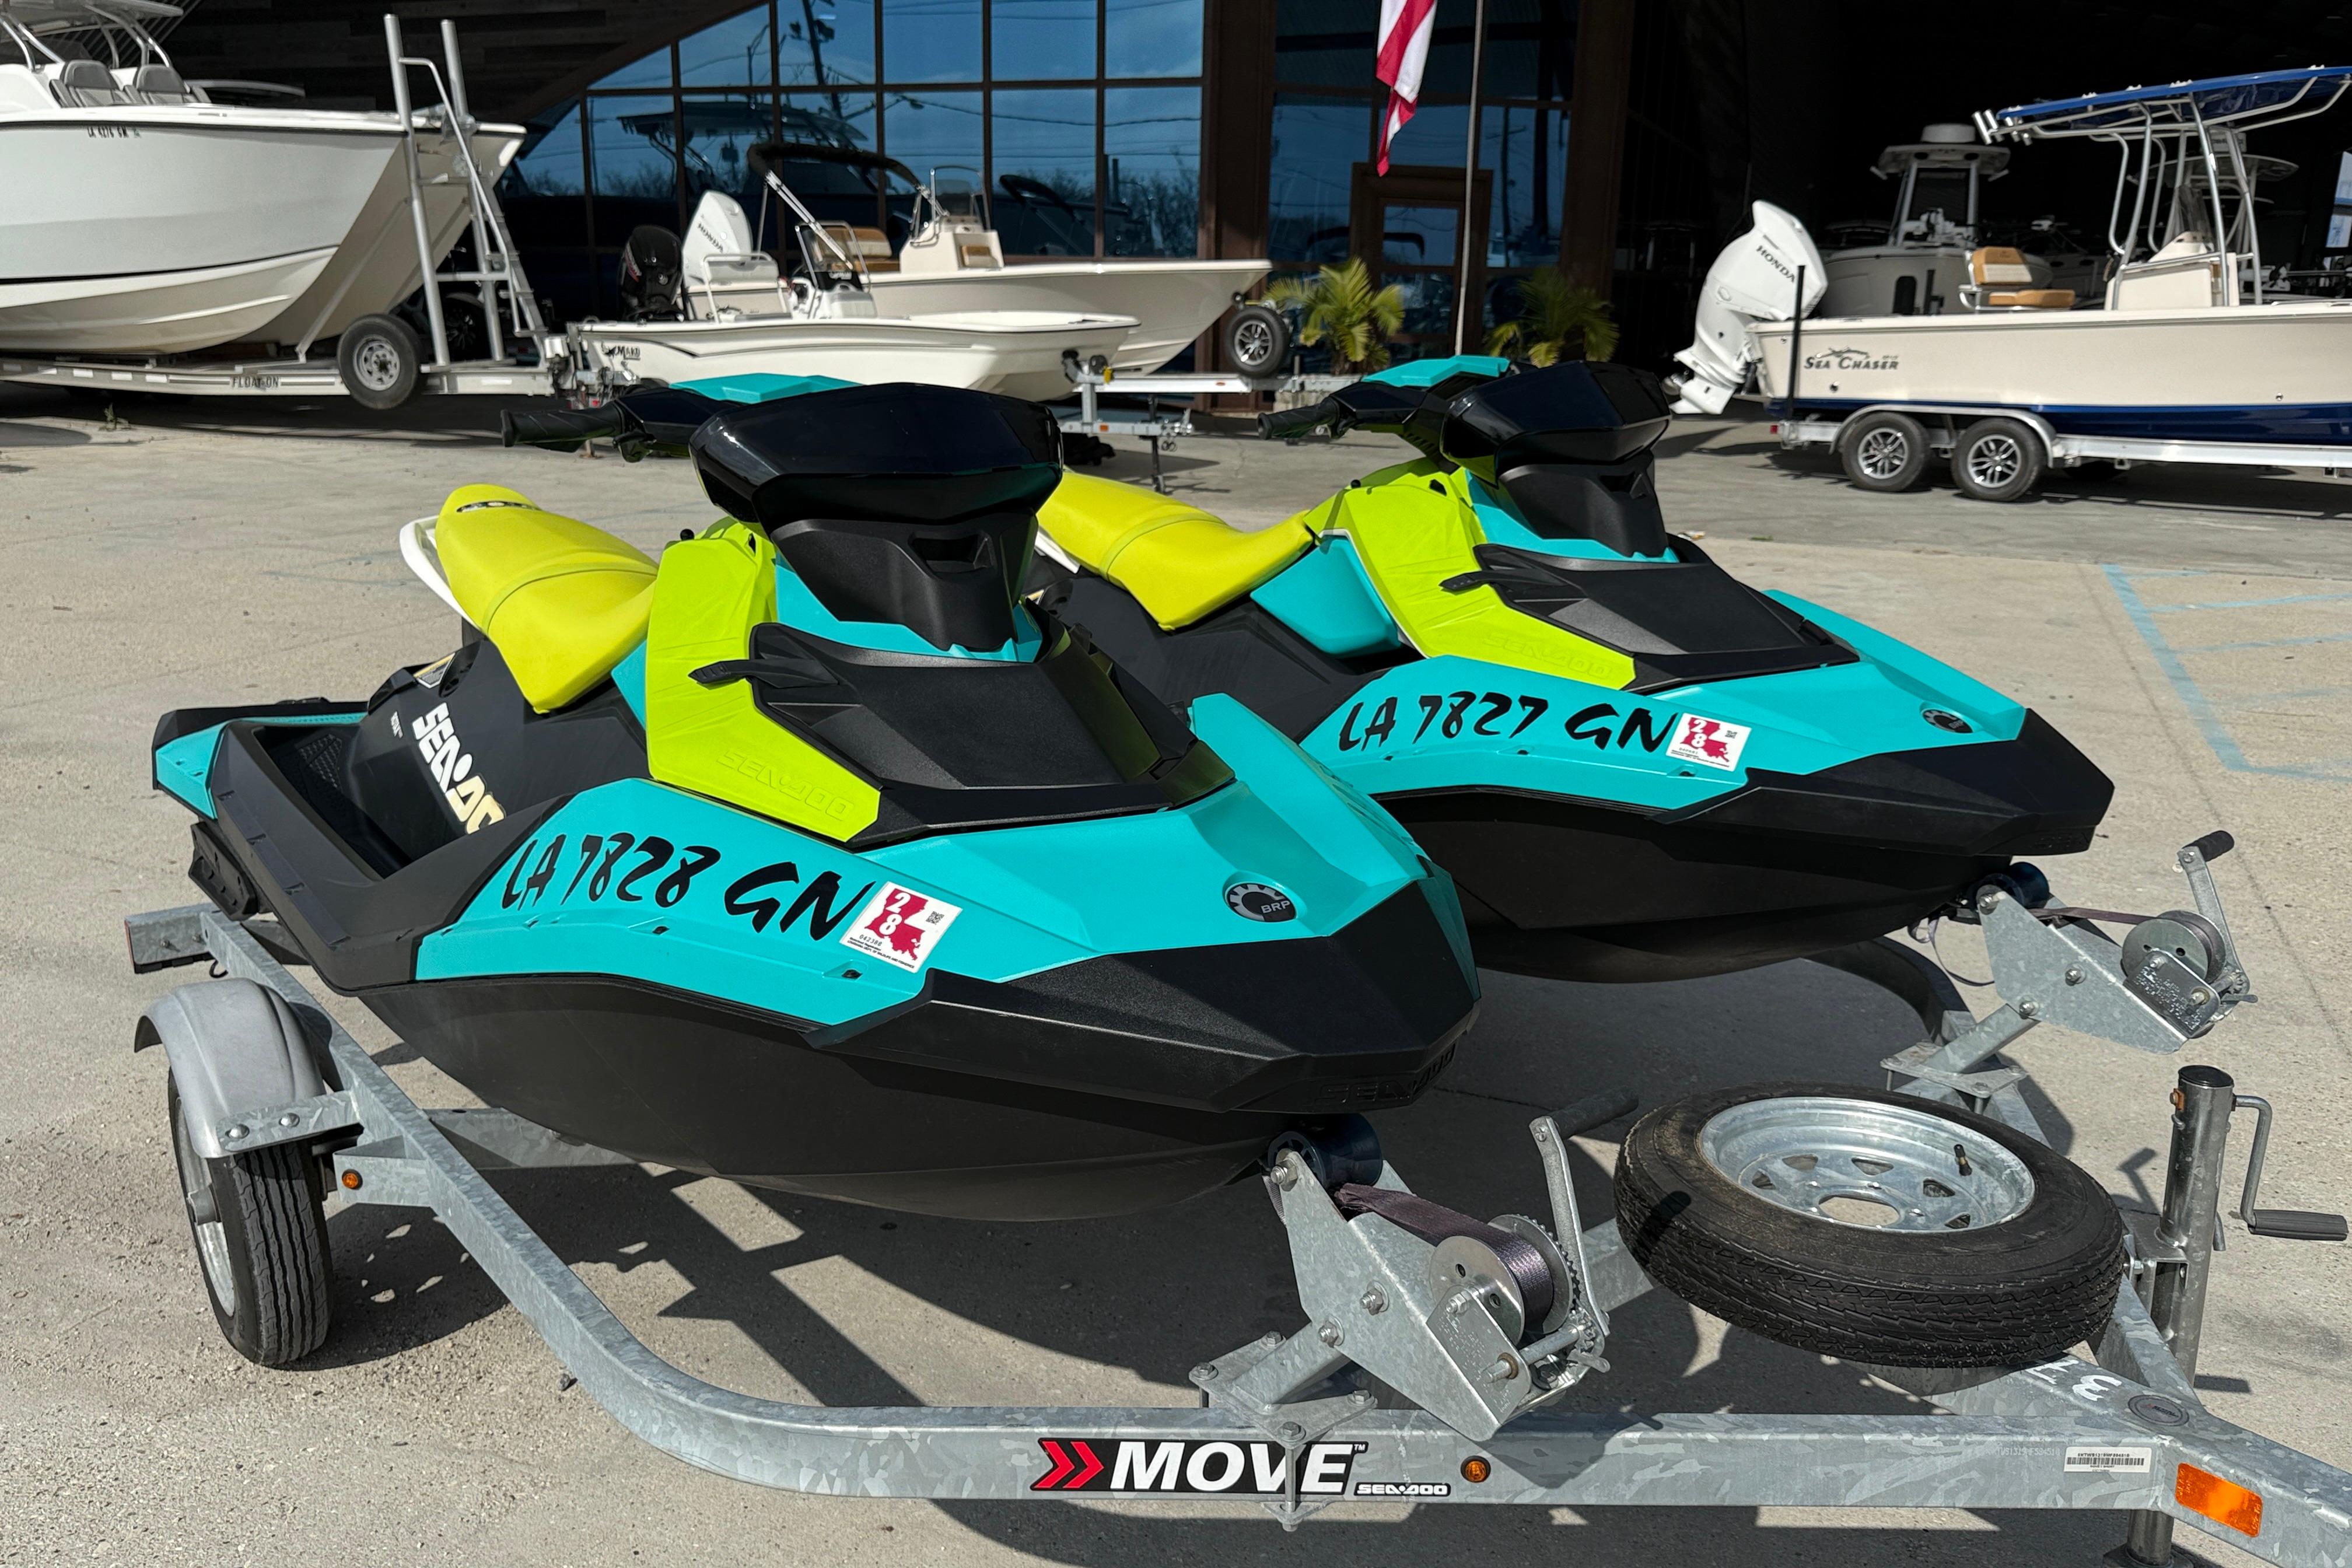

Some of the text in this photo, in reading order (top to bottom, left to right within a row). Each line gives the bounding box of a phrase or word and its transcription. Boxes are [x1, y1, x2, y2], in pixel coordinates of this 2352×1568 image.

[1756, 245, 1796, 283] HONDA
[1804, 356, 1899, 369] SEA CHASER
[1339, 691, 1679, 752] LA 7827 GN
[502, 832, 877, 941] LA 7828 GN
[1261, 900, 1290, 914] BRP
[1110, 1441, 1353, 1493] MOVE
